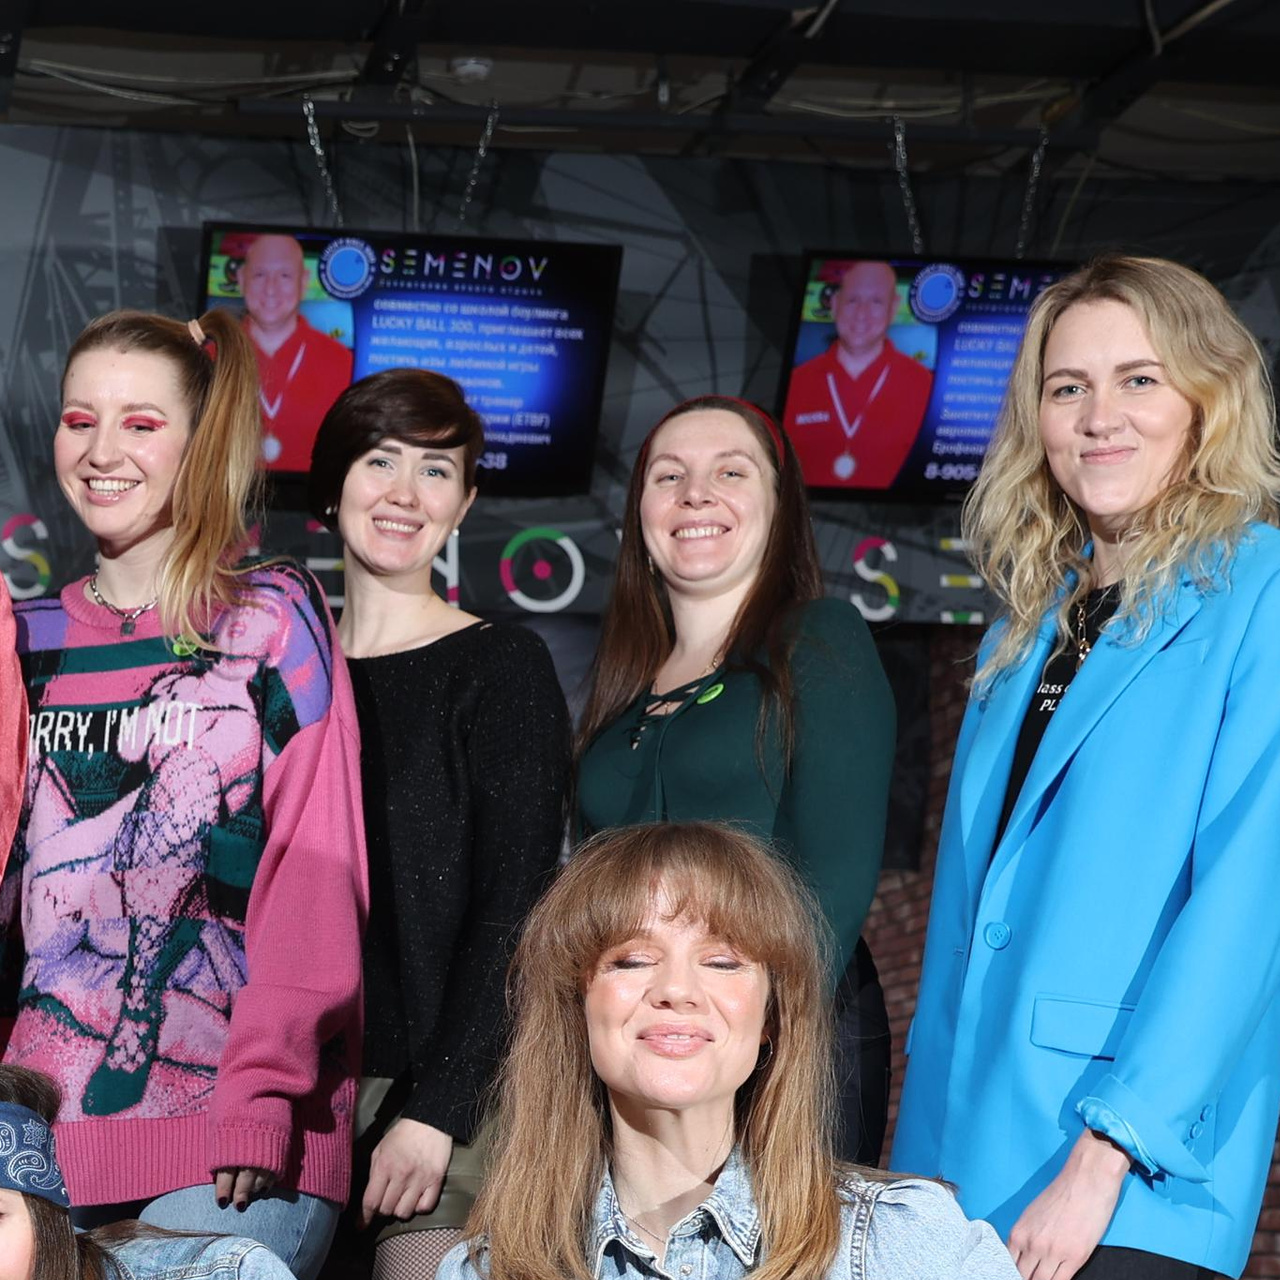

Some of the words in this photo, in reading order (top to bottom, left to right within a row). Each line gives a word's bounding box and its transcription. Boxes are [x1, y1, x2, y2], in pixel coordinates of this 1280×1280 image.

[380, 248, 549, 281] SEMENOV
[372, 314, 412, 330] LUCKY
[415, 317, 447, 333] BALL
[1036, 682, 1064, 694] lass
[1039, 698, 1063, 711] PL
[144, 700, 204, 751] NOT
